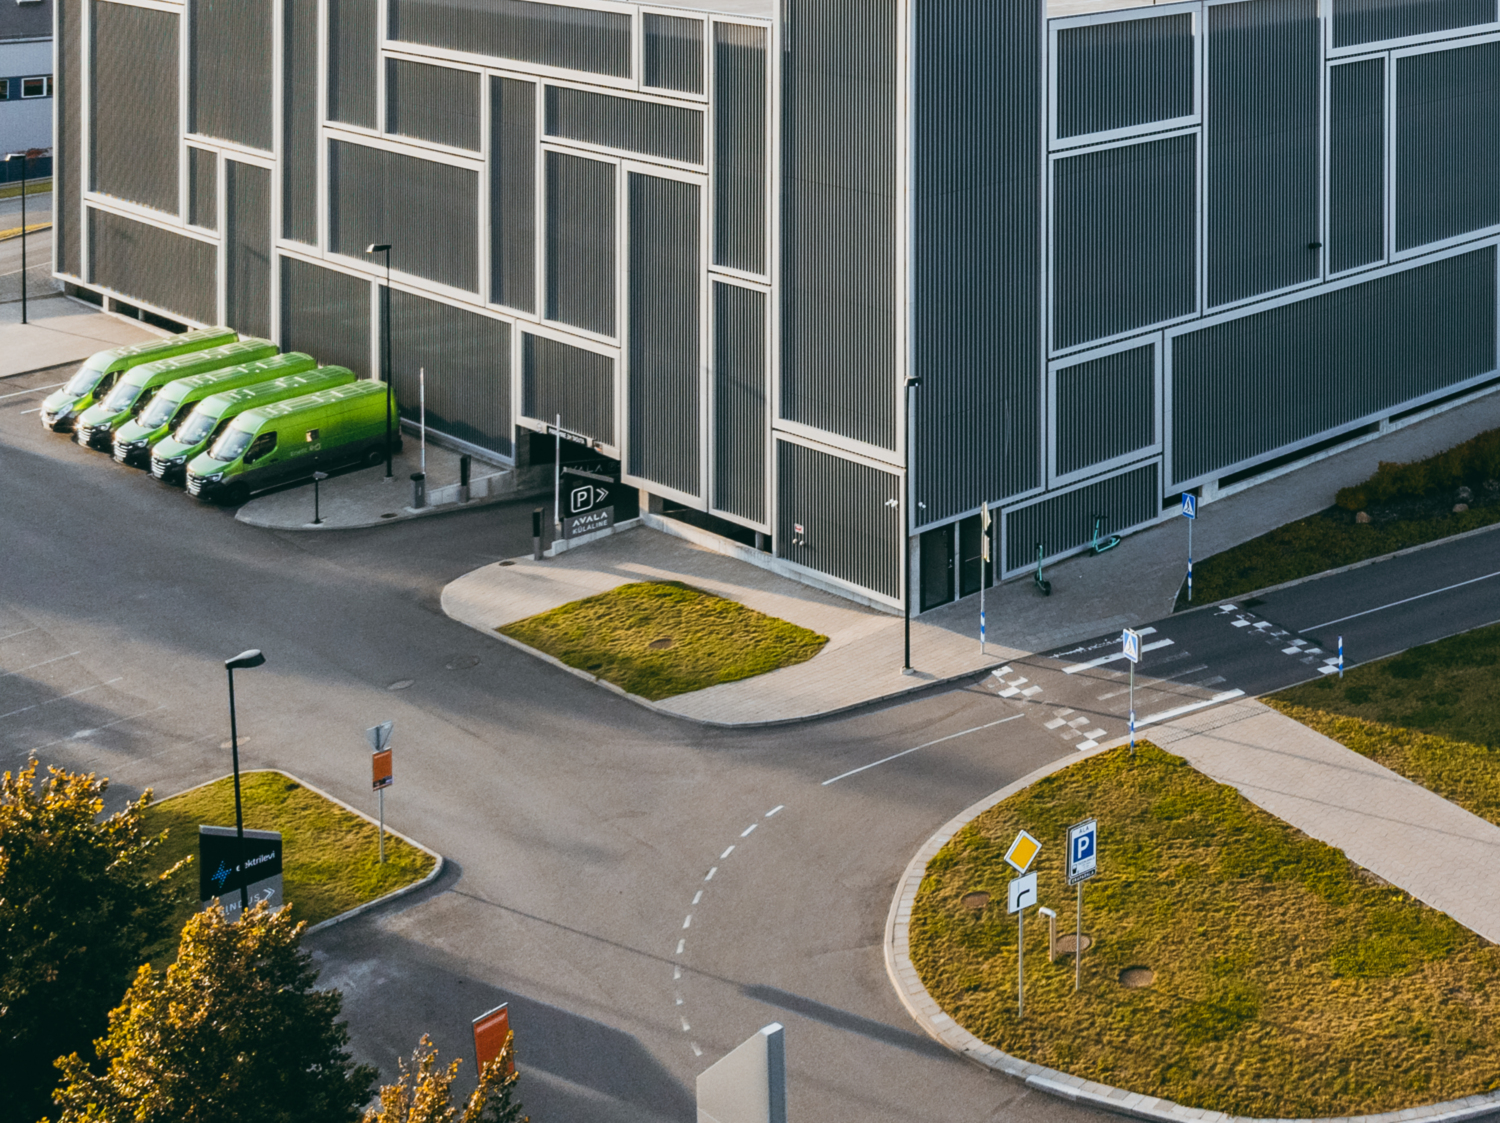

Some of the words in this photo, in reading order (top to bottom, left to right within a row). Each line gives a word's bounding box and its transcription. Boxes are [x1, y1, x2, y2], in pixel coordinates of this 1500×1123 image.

[576, 491, 588, 508] P
[572, 511, 608, 528] AVALA
[1077, 836, 1090, 860] P
[235, 850, 276, 872] eektrilevi
